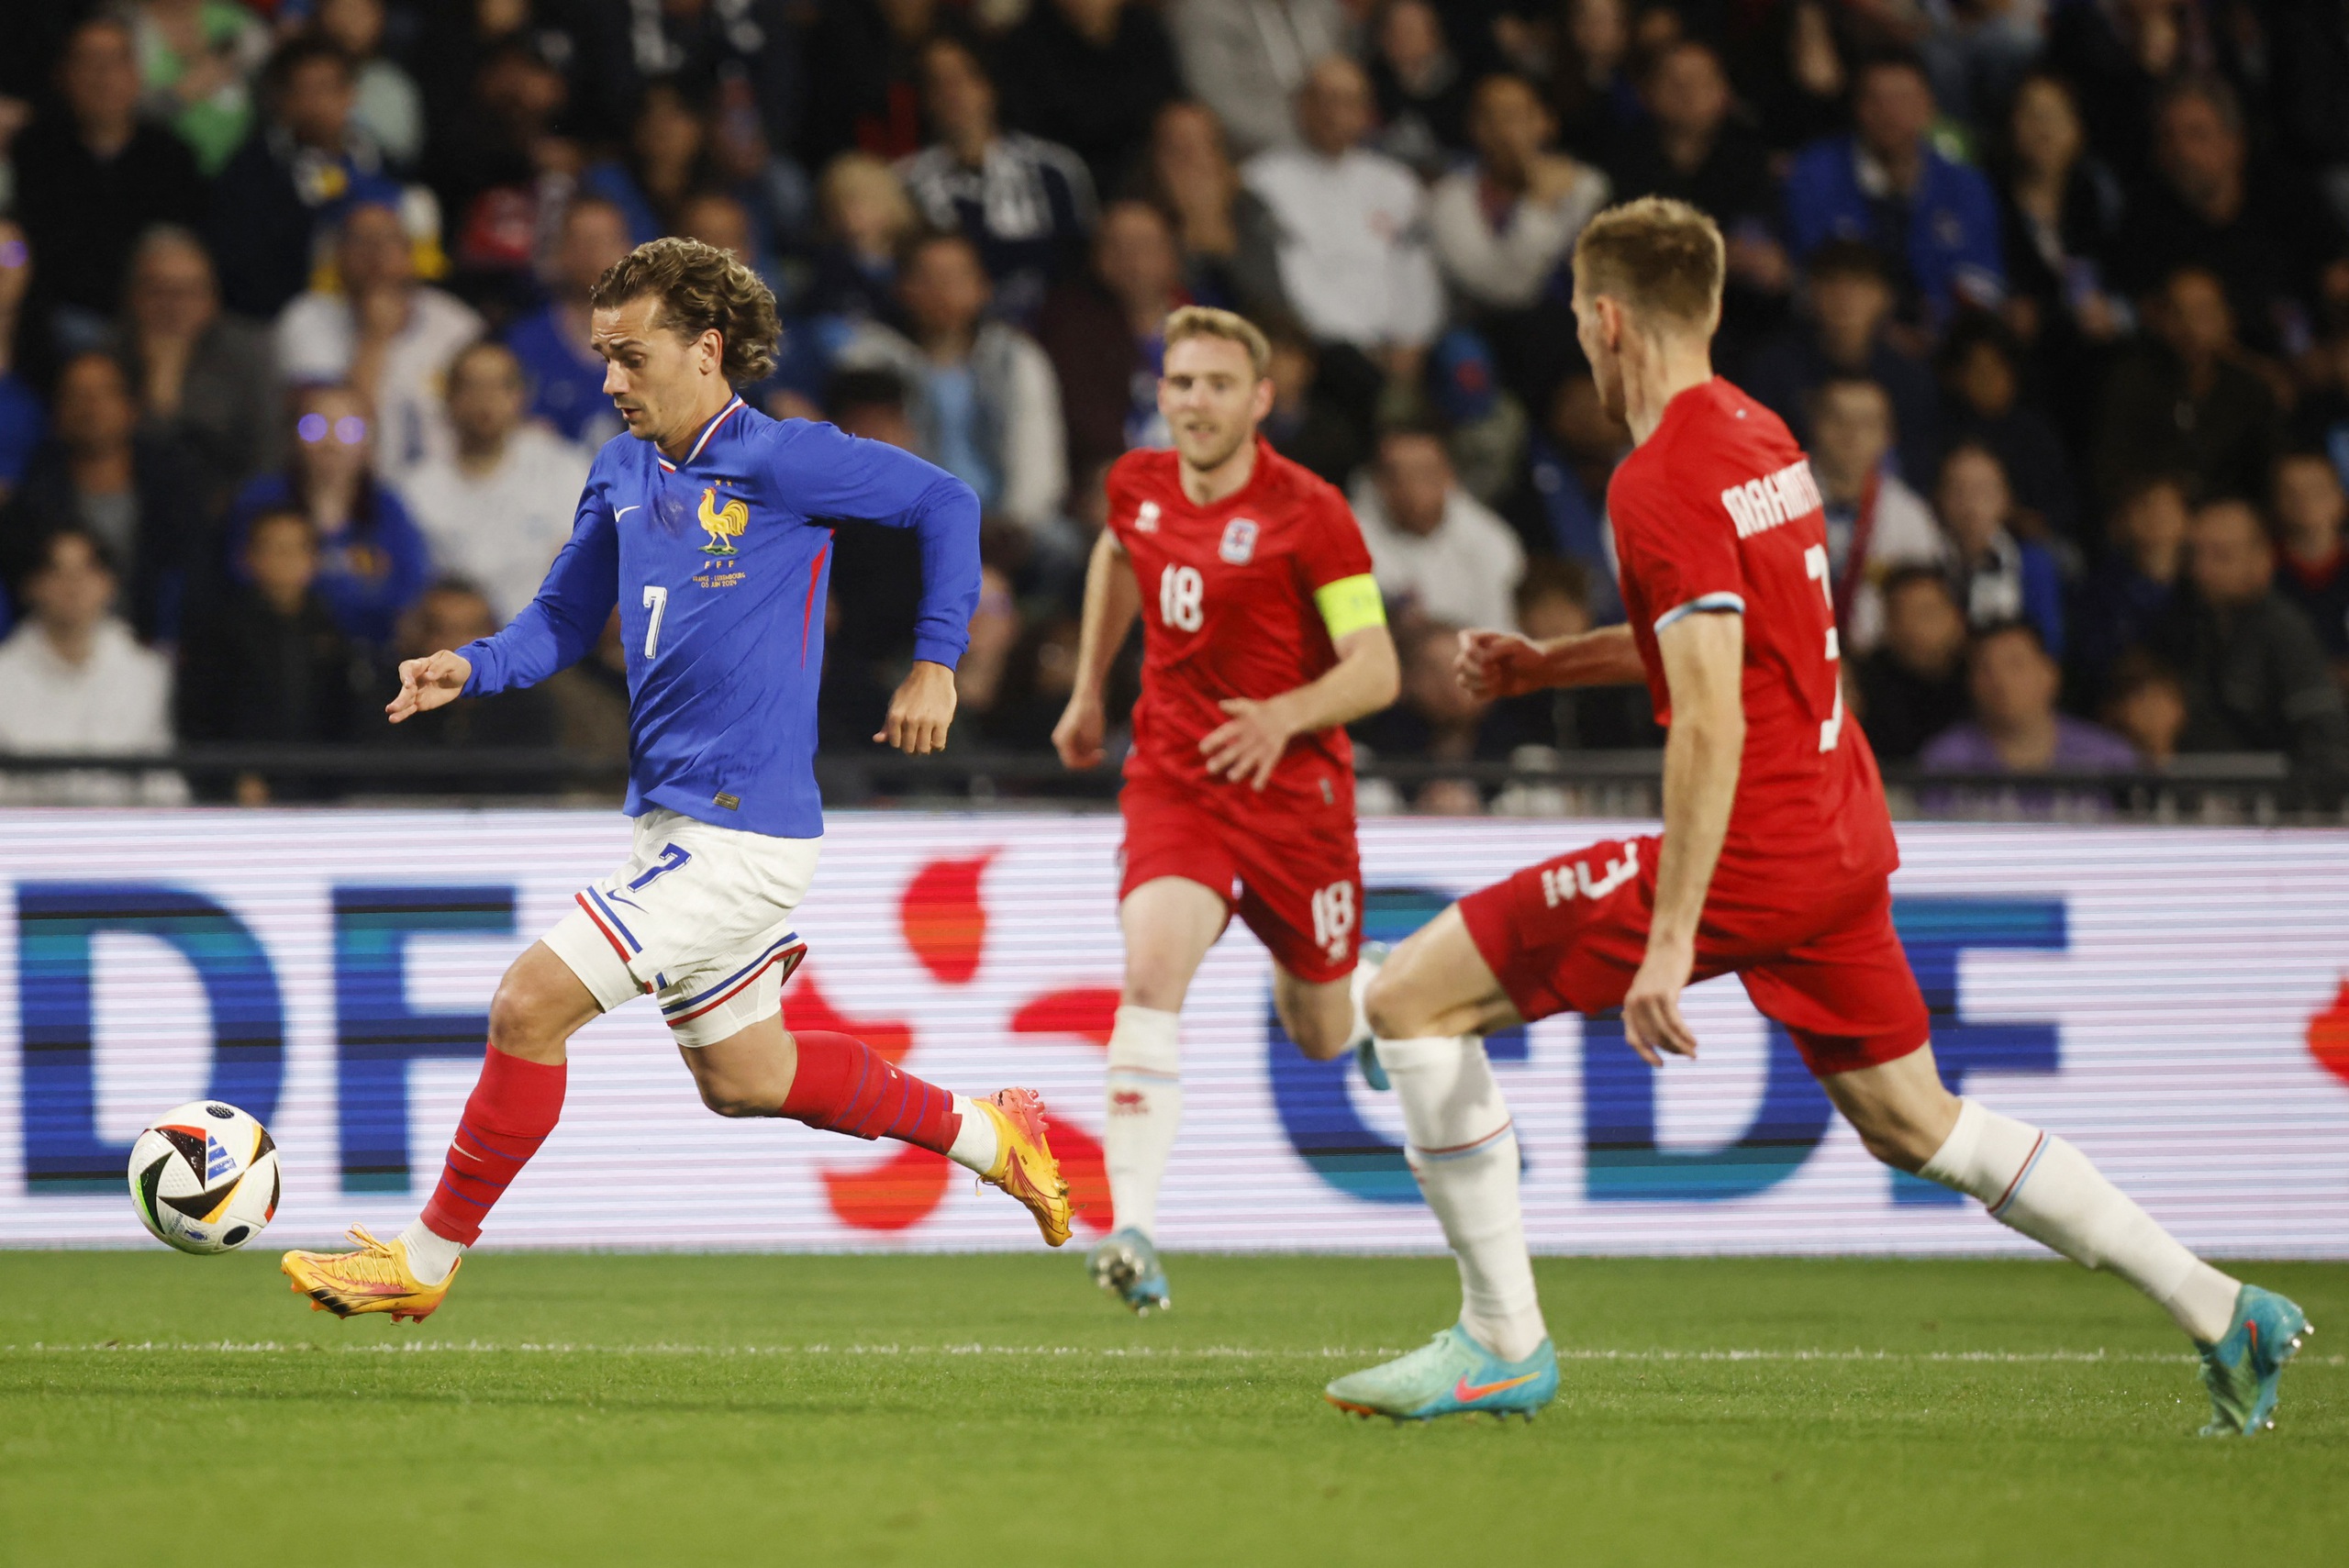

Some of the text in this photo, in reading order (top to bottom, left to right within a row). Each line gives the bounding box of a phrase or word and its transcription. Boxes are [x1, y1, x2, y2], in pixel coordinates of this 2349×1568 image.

[643, 585, 667, 659] 7
[1160, 562, 1204, 632] 18
[627, 842, 692, 893] 7
[1575, 841, 1640, 899] 3
[1310, 879, 1355, 949] 18
